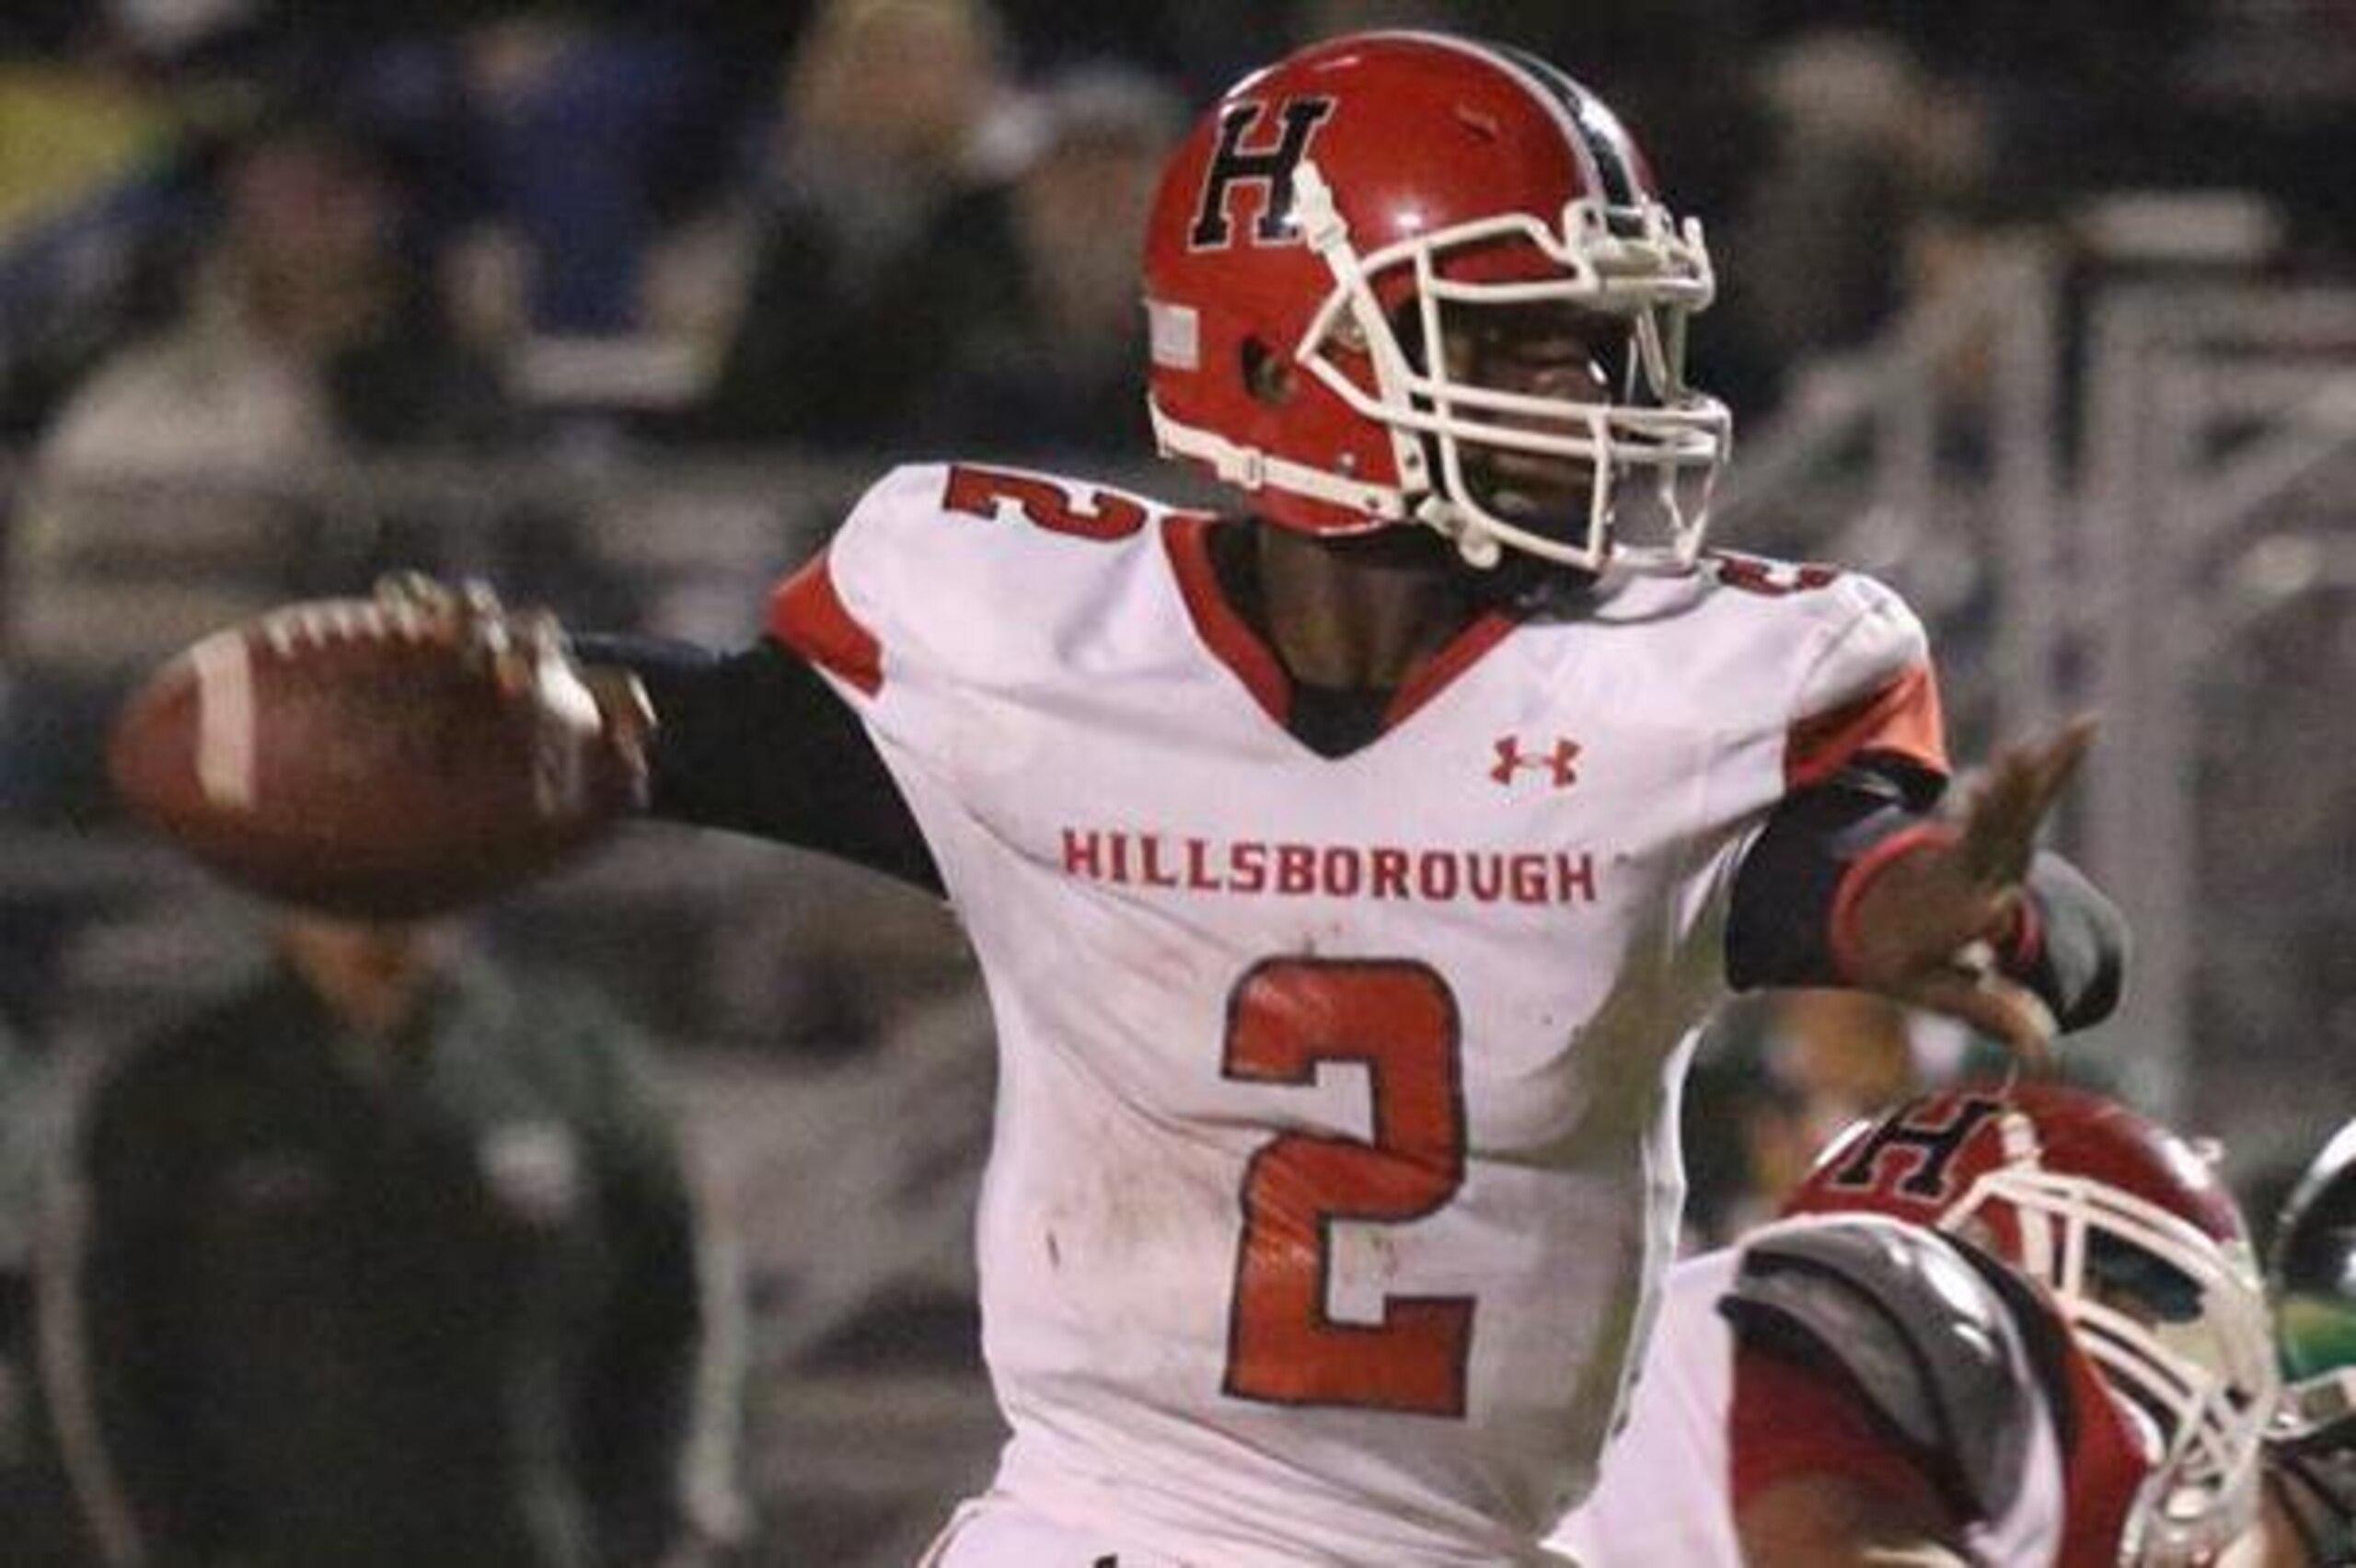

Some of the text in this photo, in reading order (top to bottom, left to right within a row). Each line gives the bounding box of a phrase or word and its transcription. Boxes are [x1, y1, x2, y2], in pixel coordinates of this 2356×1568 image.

[1191, 96, 1336, 250] H
[943, 465, 1149, 543] 2
[1062, 828, 1597, 905] HILLSBOROUGH
[1221, 956, 1476, 1420] 2
[1829, 1097, 2007, 1202] H
